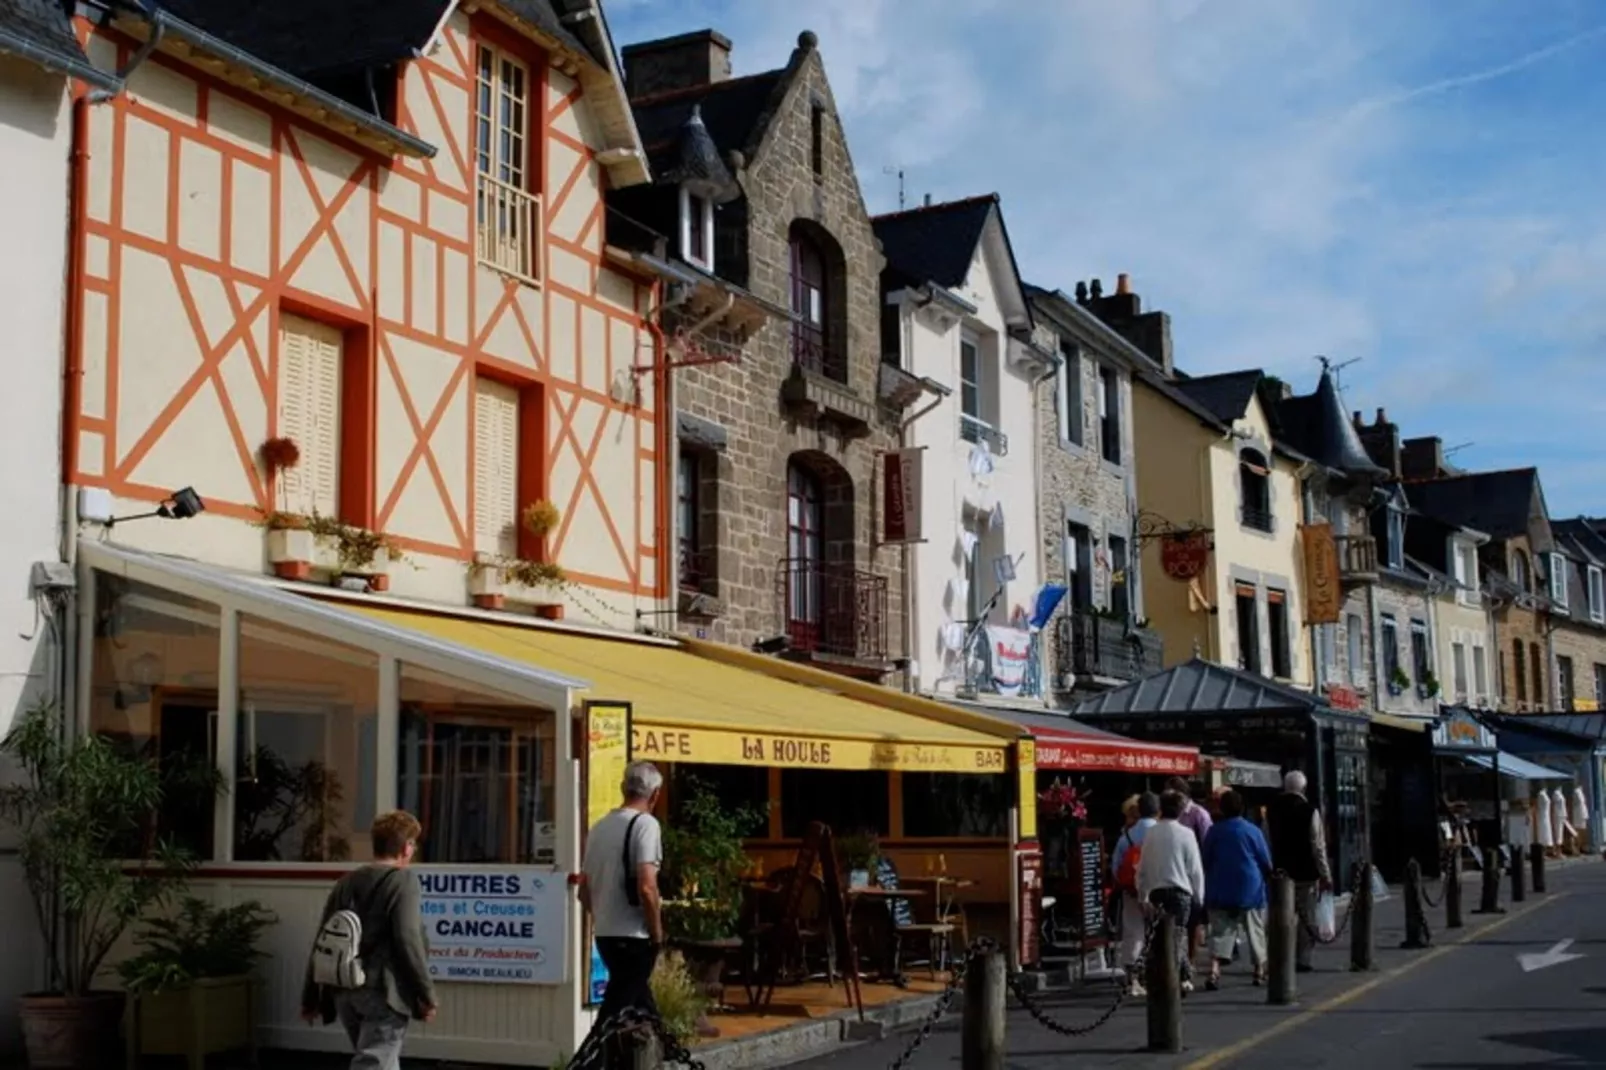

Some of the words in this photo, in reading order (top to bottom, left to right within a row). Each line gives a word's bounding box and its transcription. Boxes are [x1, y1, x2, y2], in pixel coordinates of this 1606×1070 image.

[741, 737, 765, 760] LA
[772, 739, 831, 764] HOULE
[975, 751, 1003, 768] BAR
[418, 874, 521, 894] HUITRES
[420, 901, 446, 915] tes
[453, 901, 467, 915] et
[473, 900, 535, 916] Creuses
[436, 920, 534, 938] CANCALE
[453, 946, 469, 957] du
[447, 966, 481, 978] SIMON
